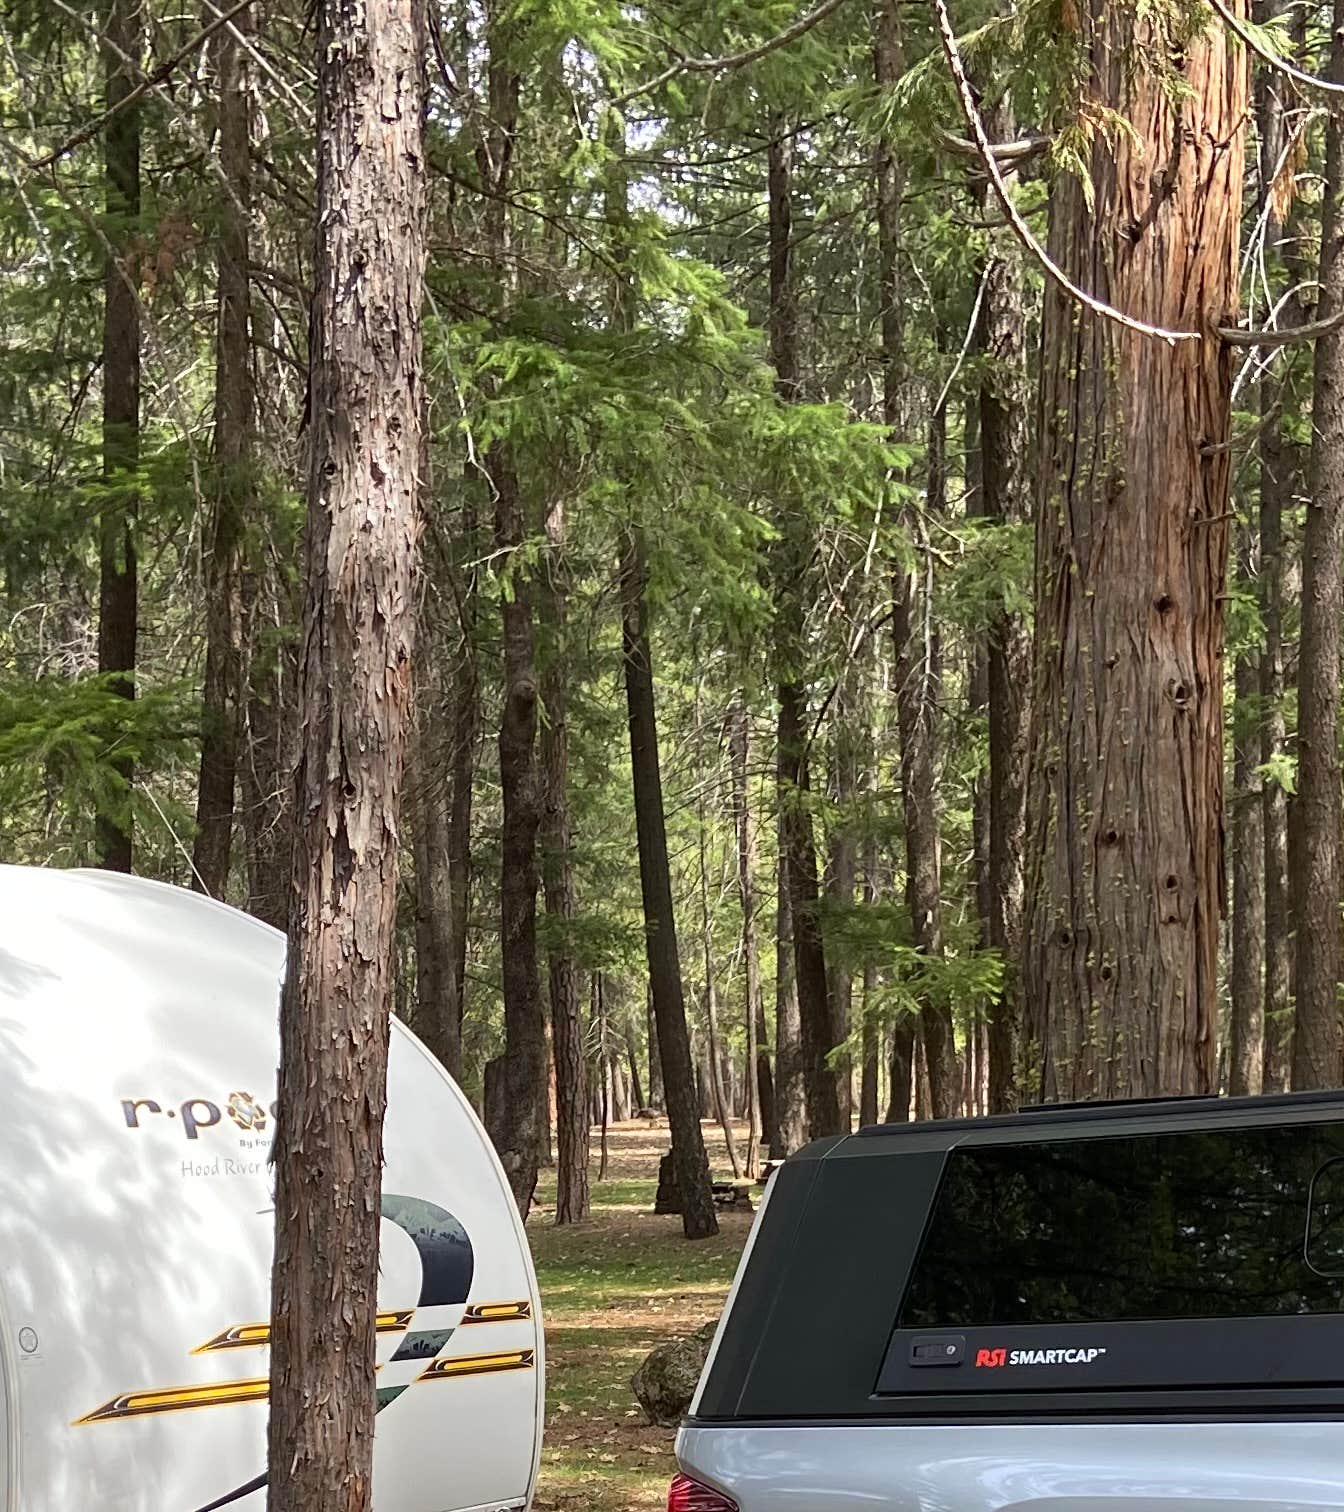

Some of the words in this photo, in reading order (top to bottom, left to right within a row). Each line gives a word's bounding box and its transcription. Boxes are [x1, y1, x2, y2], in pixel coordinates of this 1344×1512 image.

[181, 1154, 220, 1177] Hood
[224, 1158, 260, 1176] River
[975, 1348, 1007, 1367] RSI
